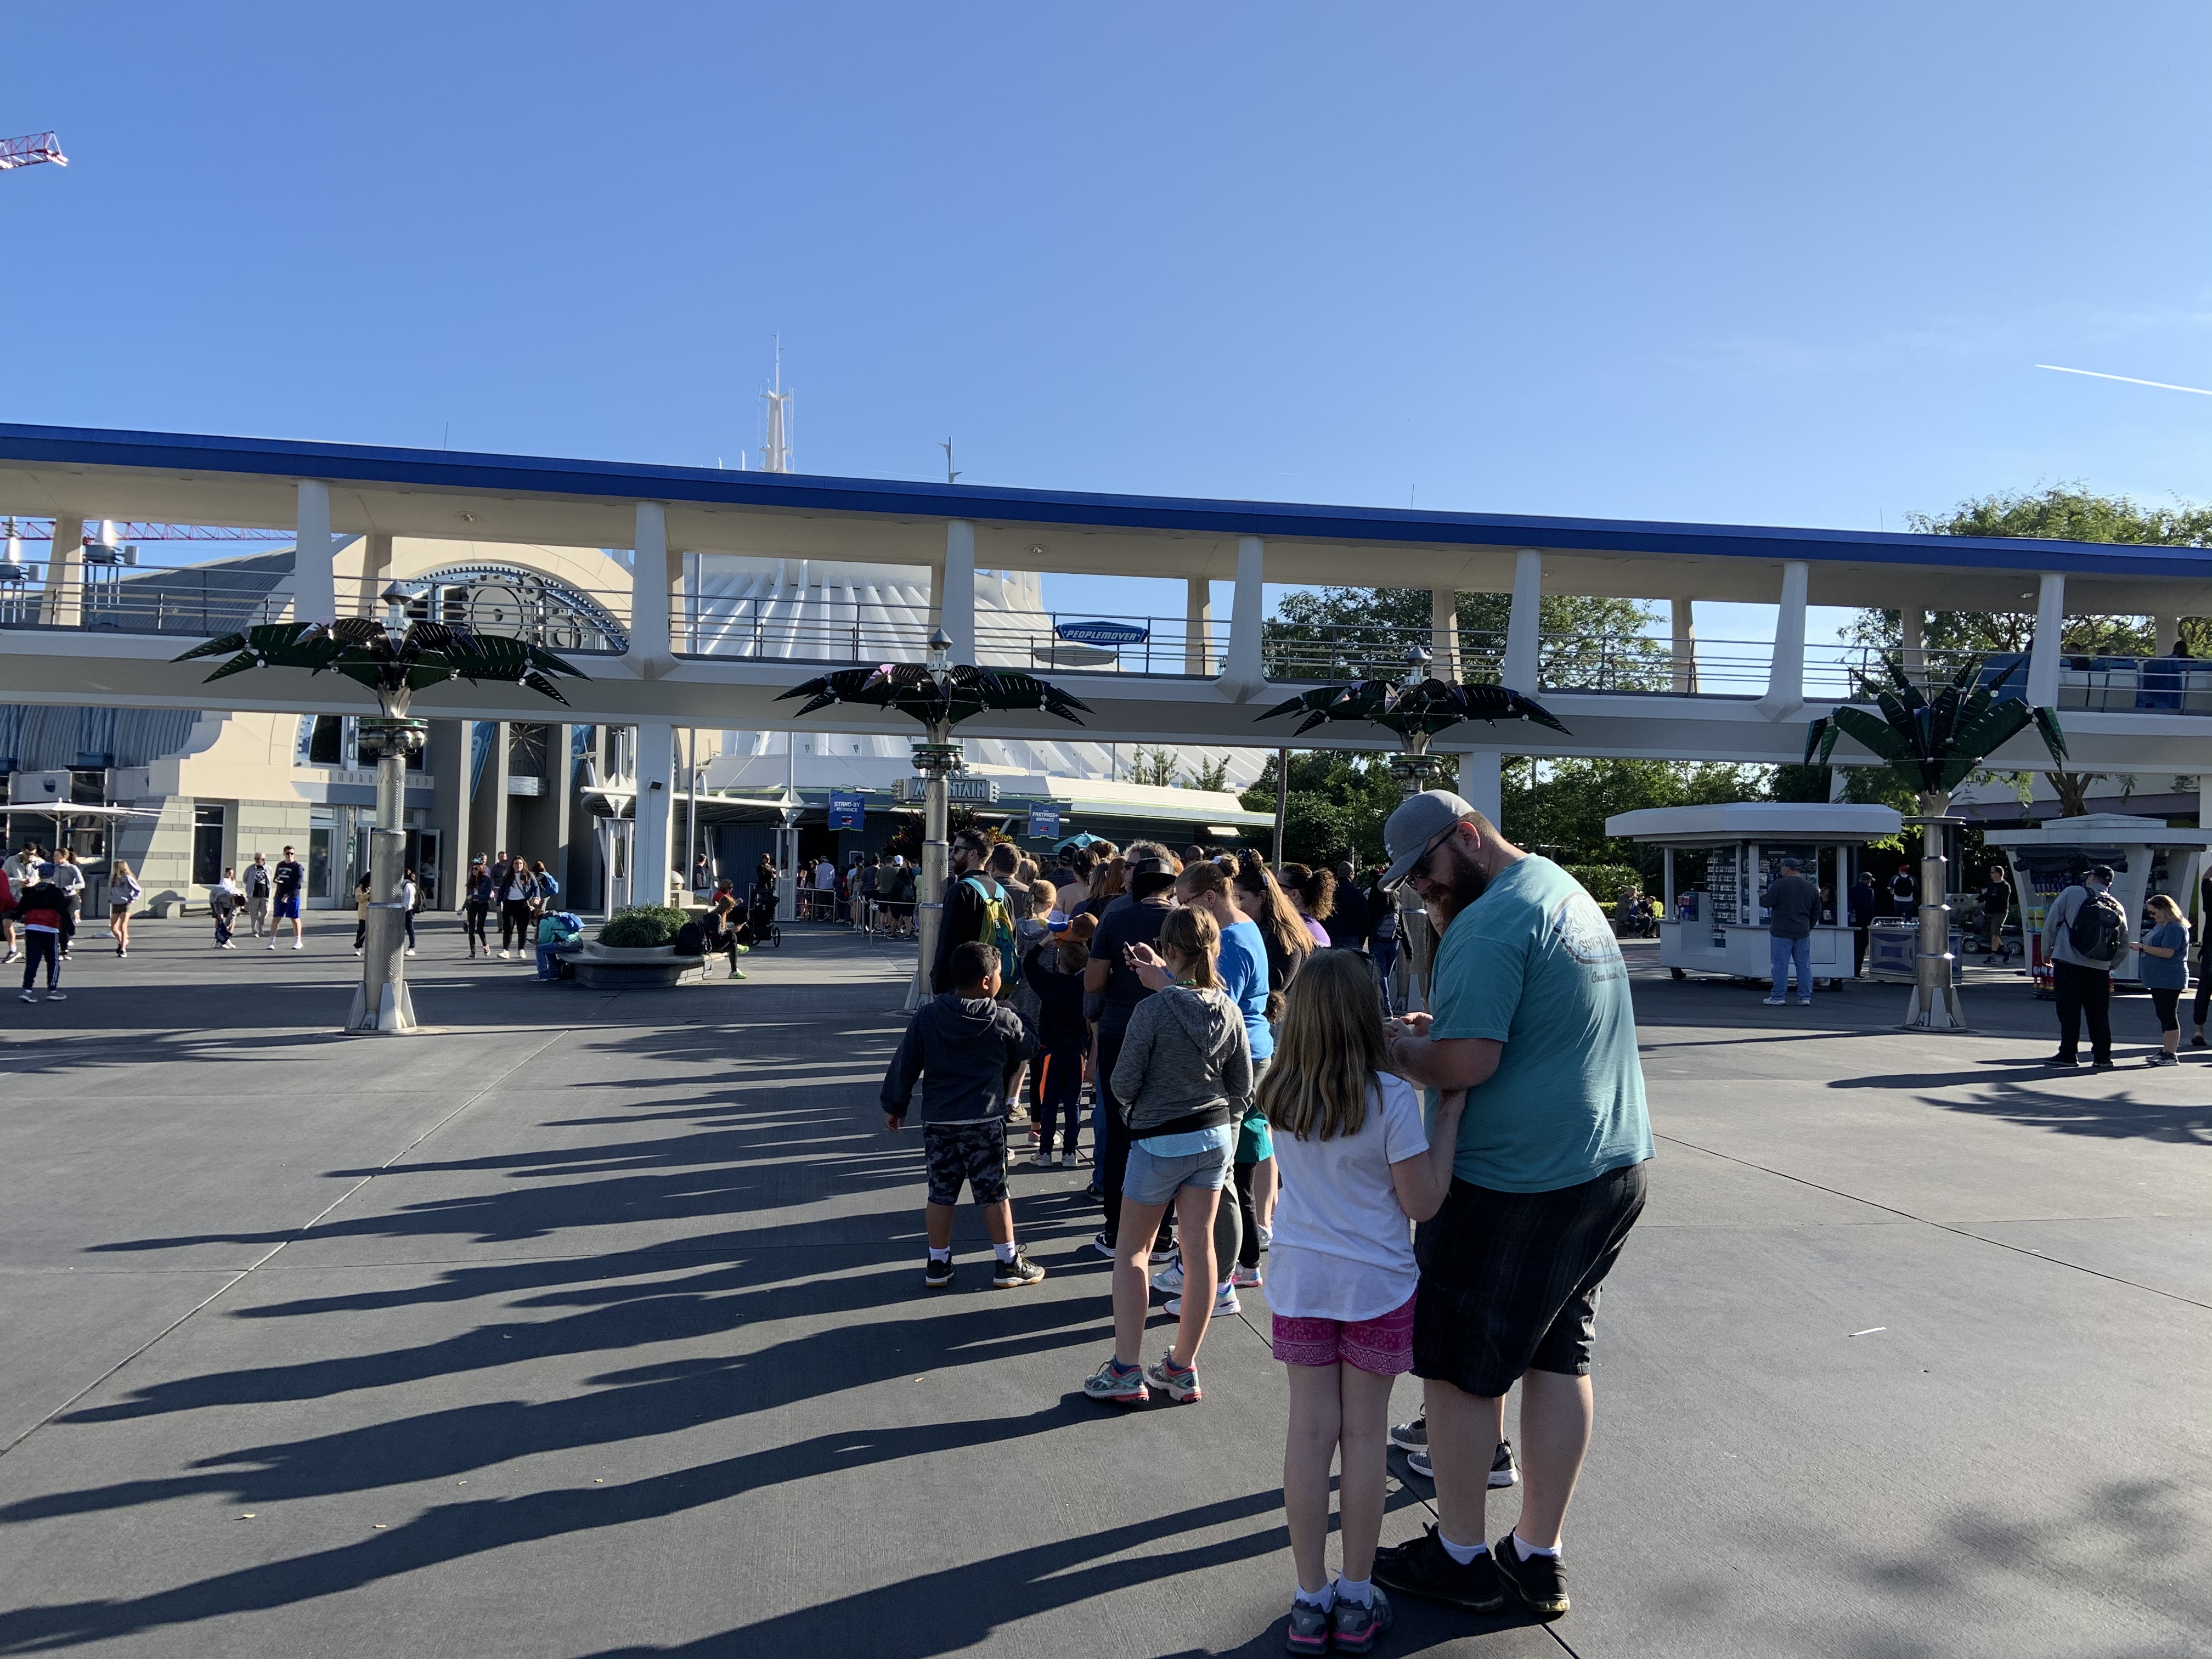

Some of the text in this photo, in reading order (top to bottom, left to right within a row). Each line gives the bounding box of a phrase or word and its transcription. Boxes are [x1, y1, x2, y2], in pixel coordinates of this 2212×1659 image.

[1066, 630, 1137, 641] PEOPLEMOVER
[318, 771, 428, 786] TOMORRAND
[913, 780, 986, 799] MNTAIN
